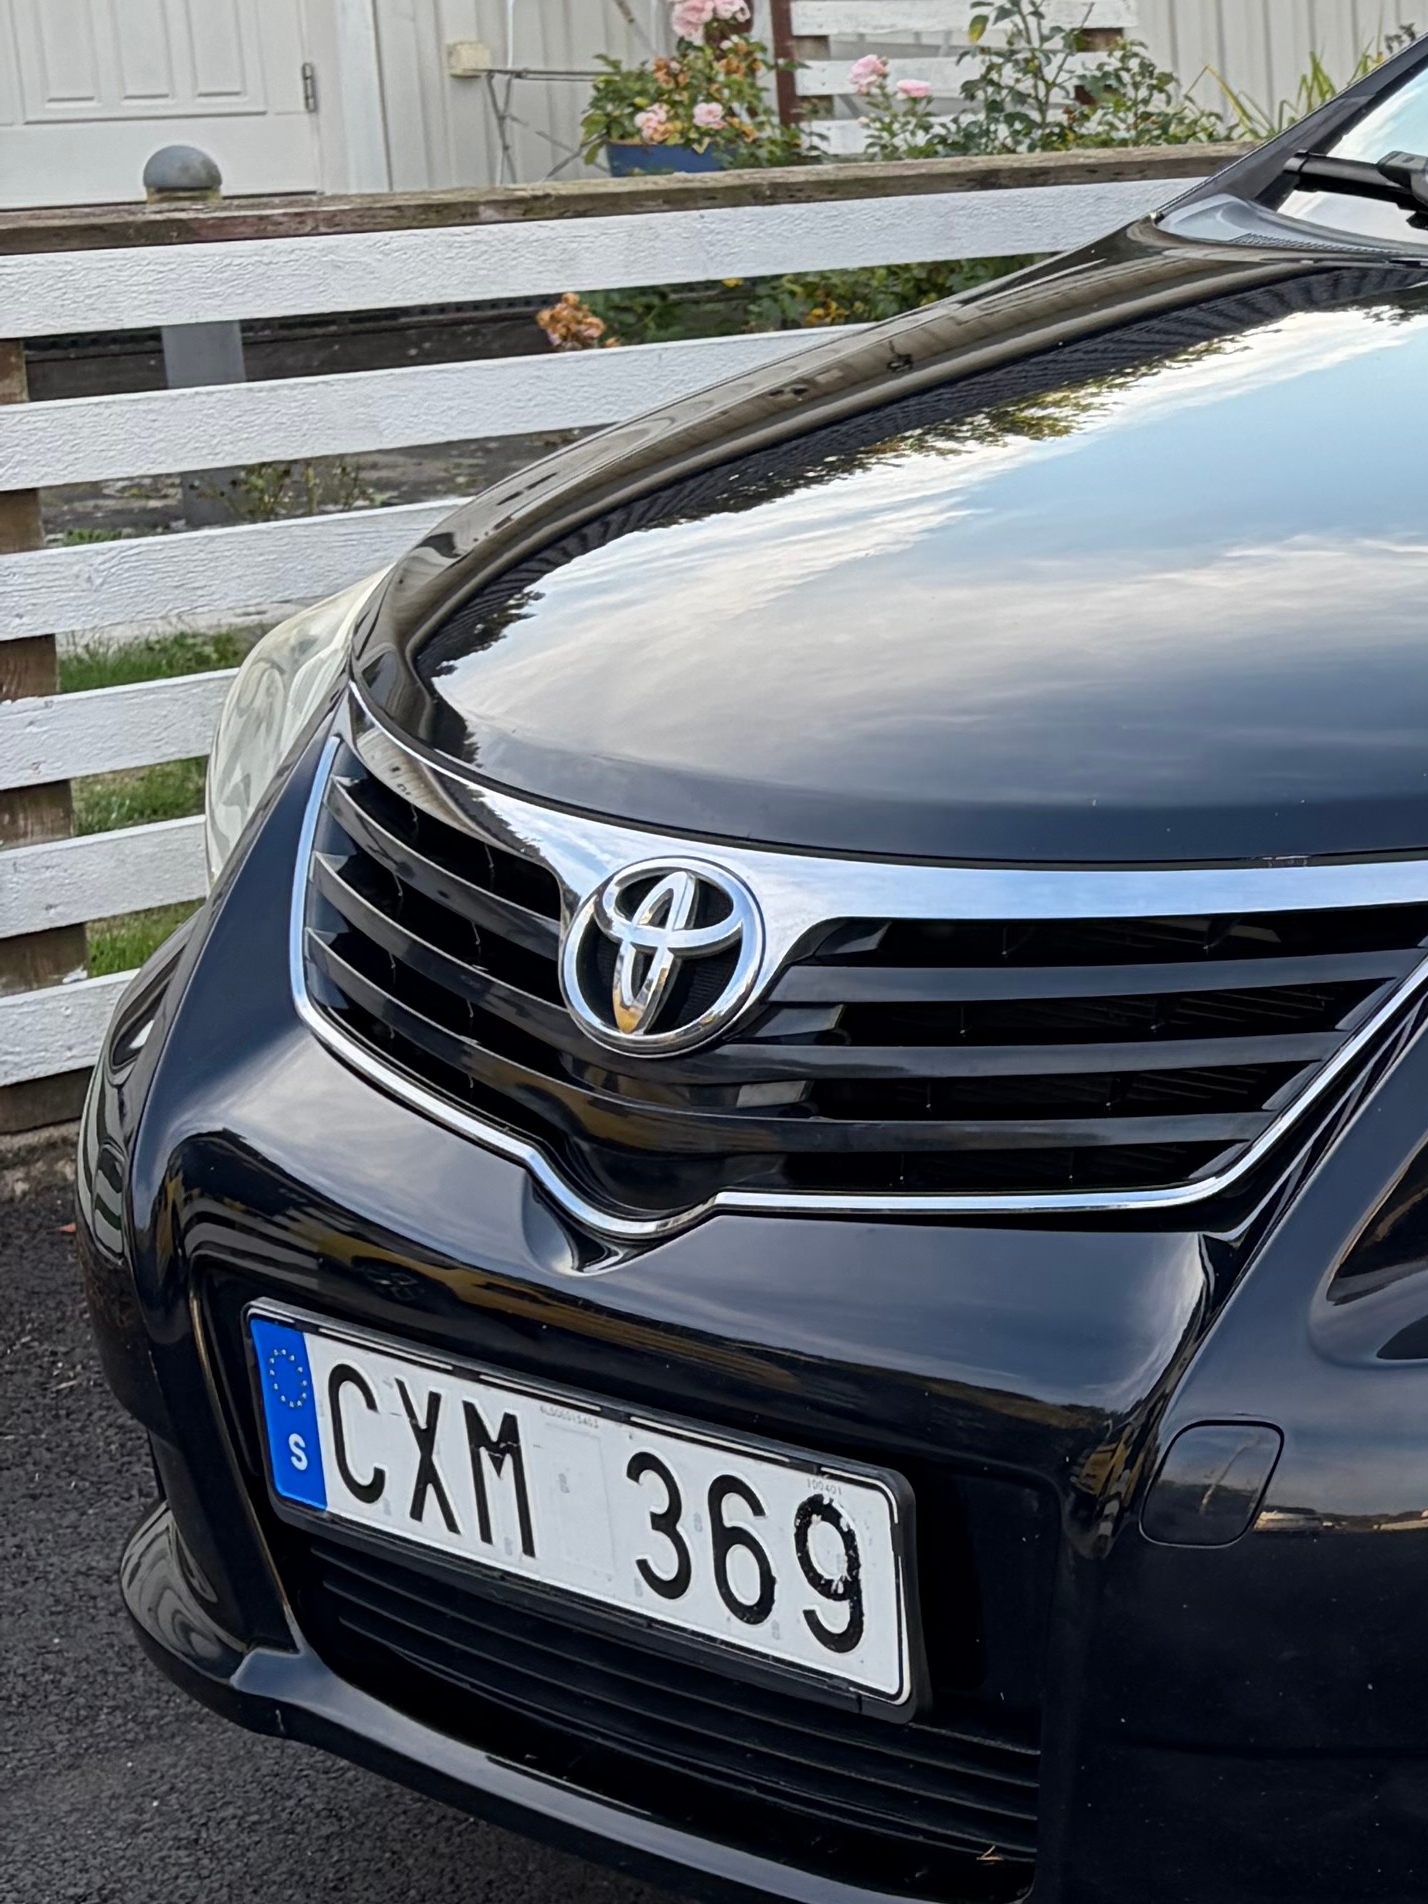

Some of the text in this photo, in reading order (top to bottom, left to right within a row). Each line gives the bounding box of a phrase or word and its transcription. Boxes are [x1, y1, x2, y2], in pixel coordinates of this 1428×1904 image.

[288, 1432, 309, 1471] S
[328, 1363, 864, 1654] CXM 369
